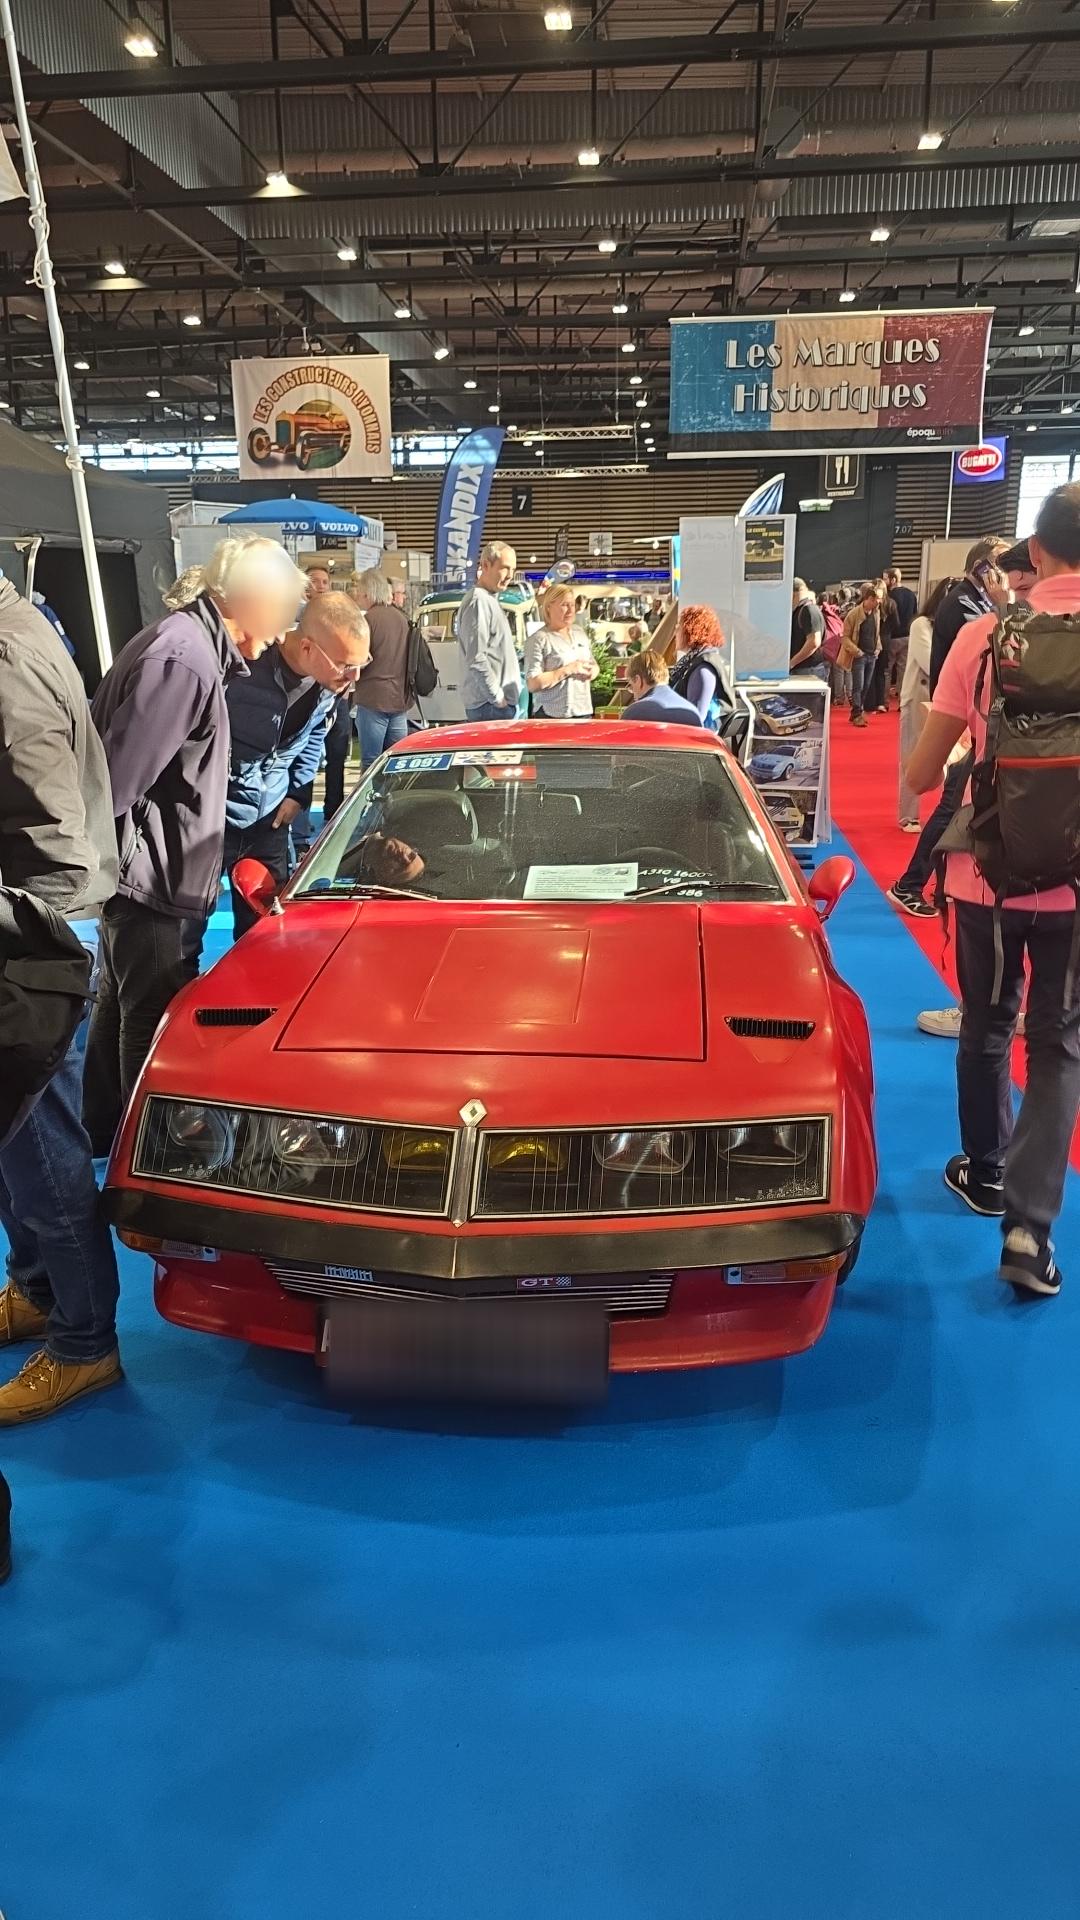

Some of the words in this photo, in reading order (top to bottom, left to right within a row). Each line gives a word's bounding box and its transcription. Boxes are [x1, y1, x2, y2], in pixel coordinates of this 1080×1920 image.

[724, 338, 782, 369] Les
[792, 336, 941, 369] Marques
[732, 380, 928, 415] Historiques
[252, 397, 274, 424] LES
[265, 365, 359, 403] CONSTRUCTEURS
[350, 388, 382, 455] LYONNAIS
[961, 453, 997, 468] BUGATTI
[517, 495, 528, 511] 7
[281, 522, 309, 530] LVO
[320, 522, 358, 532] VOLVO
[895, 526, 911, 534] 7.07
[395, 760, 407, 769] S
[409, 758, 442, 769] 097
[520, 1277, 554, 1287] GT
